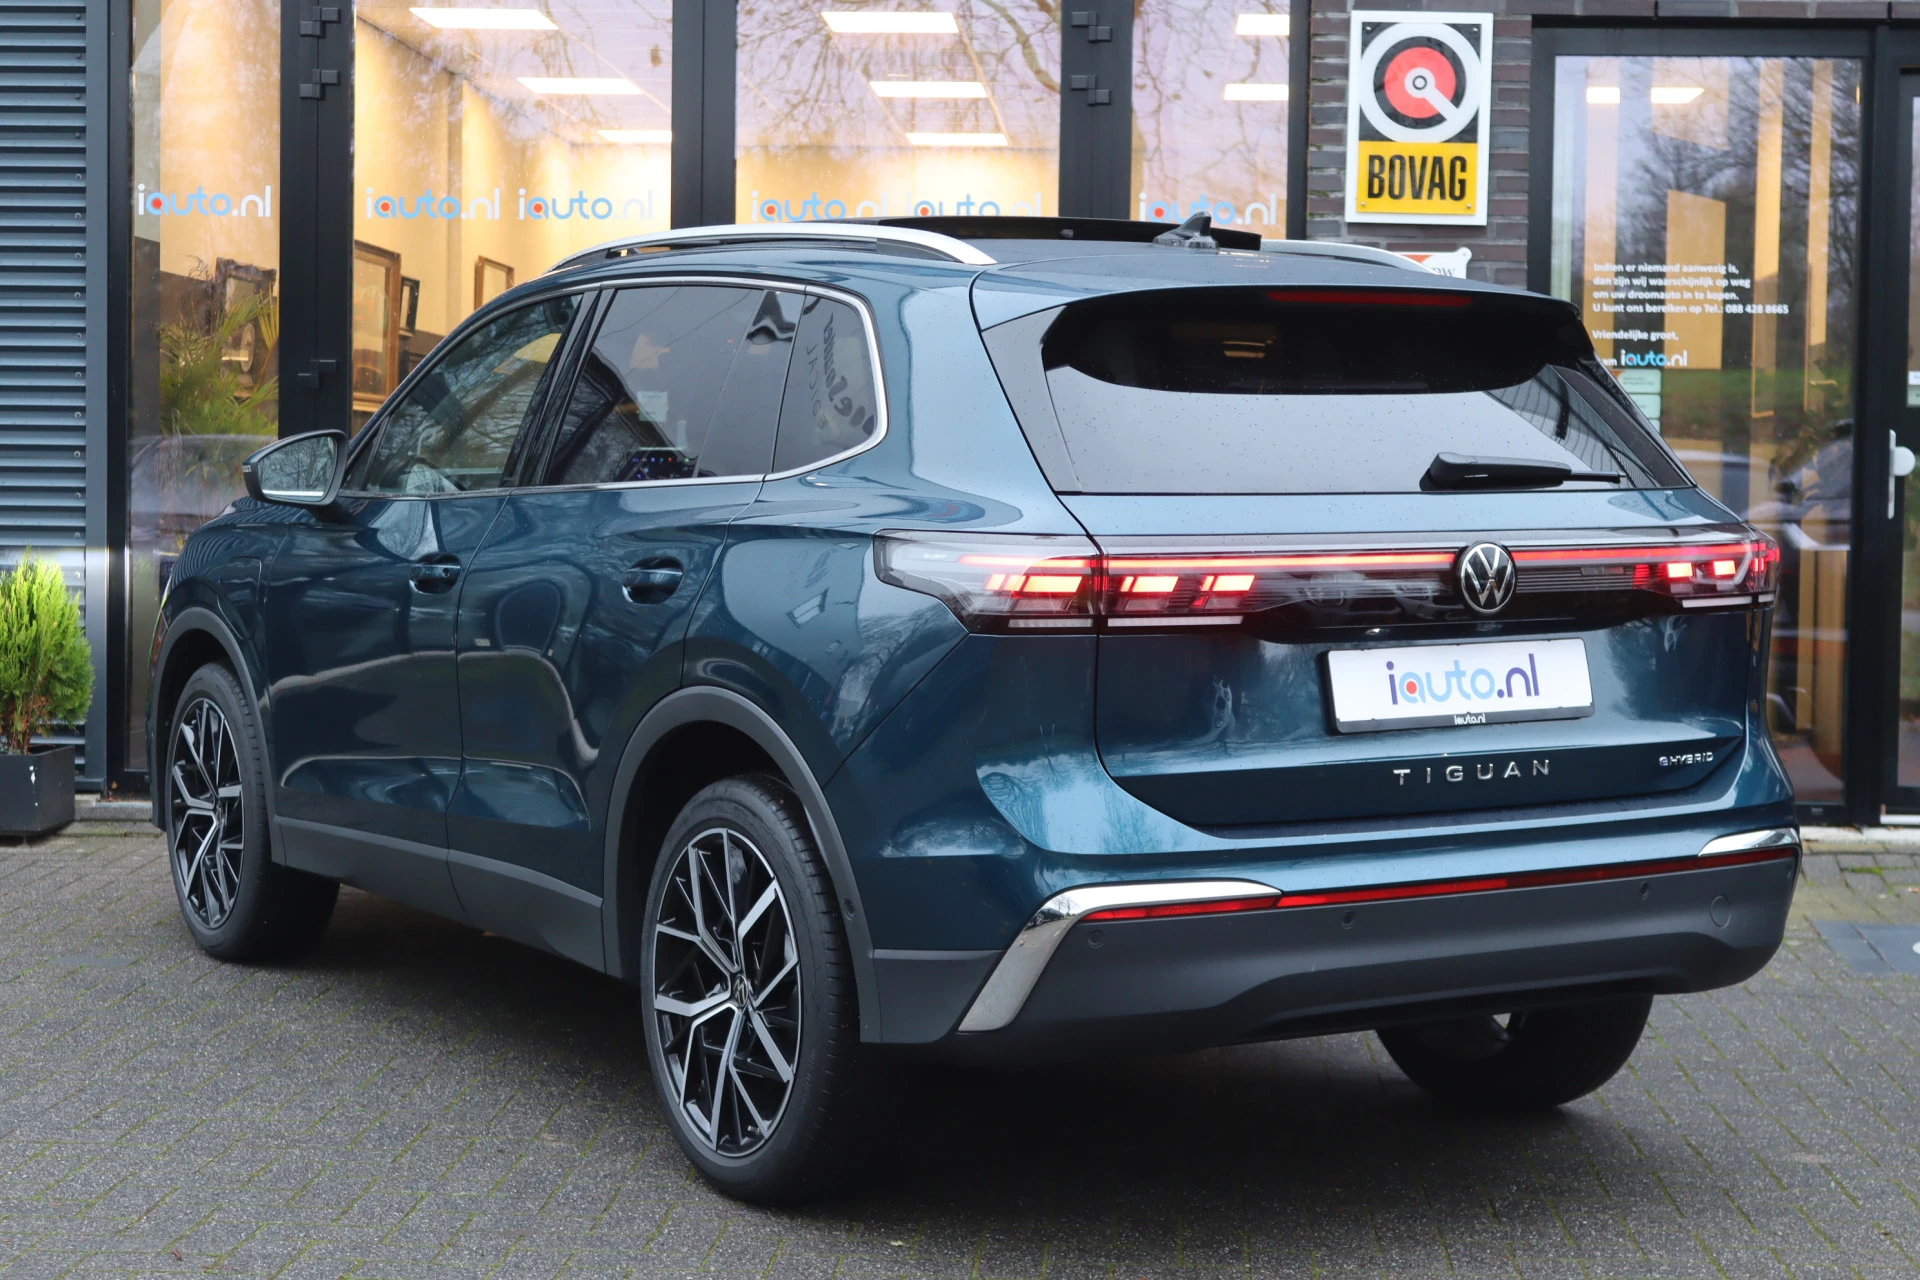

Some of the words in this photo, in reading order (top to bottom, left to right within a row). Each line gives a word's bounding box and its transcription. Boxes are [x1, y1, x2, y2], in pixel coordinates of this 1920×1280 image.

[1367, 154, 1467, 201] BOVAG
[137, 183, 272, 217] iauto.nl
[366, 187, 500, 219] iauto.nl
[518, 188, 653, 220] iauto.nl
[906, 191, 1042, 216] iautonl
[1593, 262, 1624, 272] Indien
[1625, 264, 1636, 272] er
[1638, 262, 1680, 273] niemand
[1682, 264, 1726, 275] aanwezig
[1727, 263, 1739, 274] is,
[1593, 276, 1611, 286] dan
[1614, 276, 1630, 287] zijn
[1631, 276, 1647, 287] wij
[1649, 277, 1714, 288] waarschijnlijk
[1716, 279, 1729, 288] op
[1730, 279, 1751, 289] weg
[1593, 291, 1608, 299] om
[1611, 291, 1626, 299] uw
[1628, 290, 1681, 300] droomauto
[1684, 290, 1692, 299] in
[1695, 291, 1704, 299] te
[1706, 290, 1740, 301] kopen.
[1593, 303, 1600, 312] U
[1602, 302, 1624, 313] kunt
[1626, 304, 1643, 313] ons
[1645, 302, 1687, 313] bereiken
[1689, 305, 1702, 315] op
[1725, 303, 1743, 313] 088
[1745, 303, 1763, 314] 428
[1765, 304, 1789, 314] 8665
[1592, 329, 1648, 341] Vriendelijke
[1650, 331, 1679, 342] groet,
[1620, 349, 1688, 366] iauto.nl
[1386, 653, 1540, 705] iauto.nl
[1454, 713, 1486, 725] iauto.nl
[1393, 760, 1549, 785] TIGUAN
